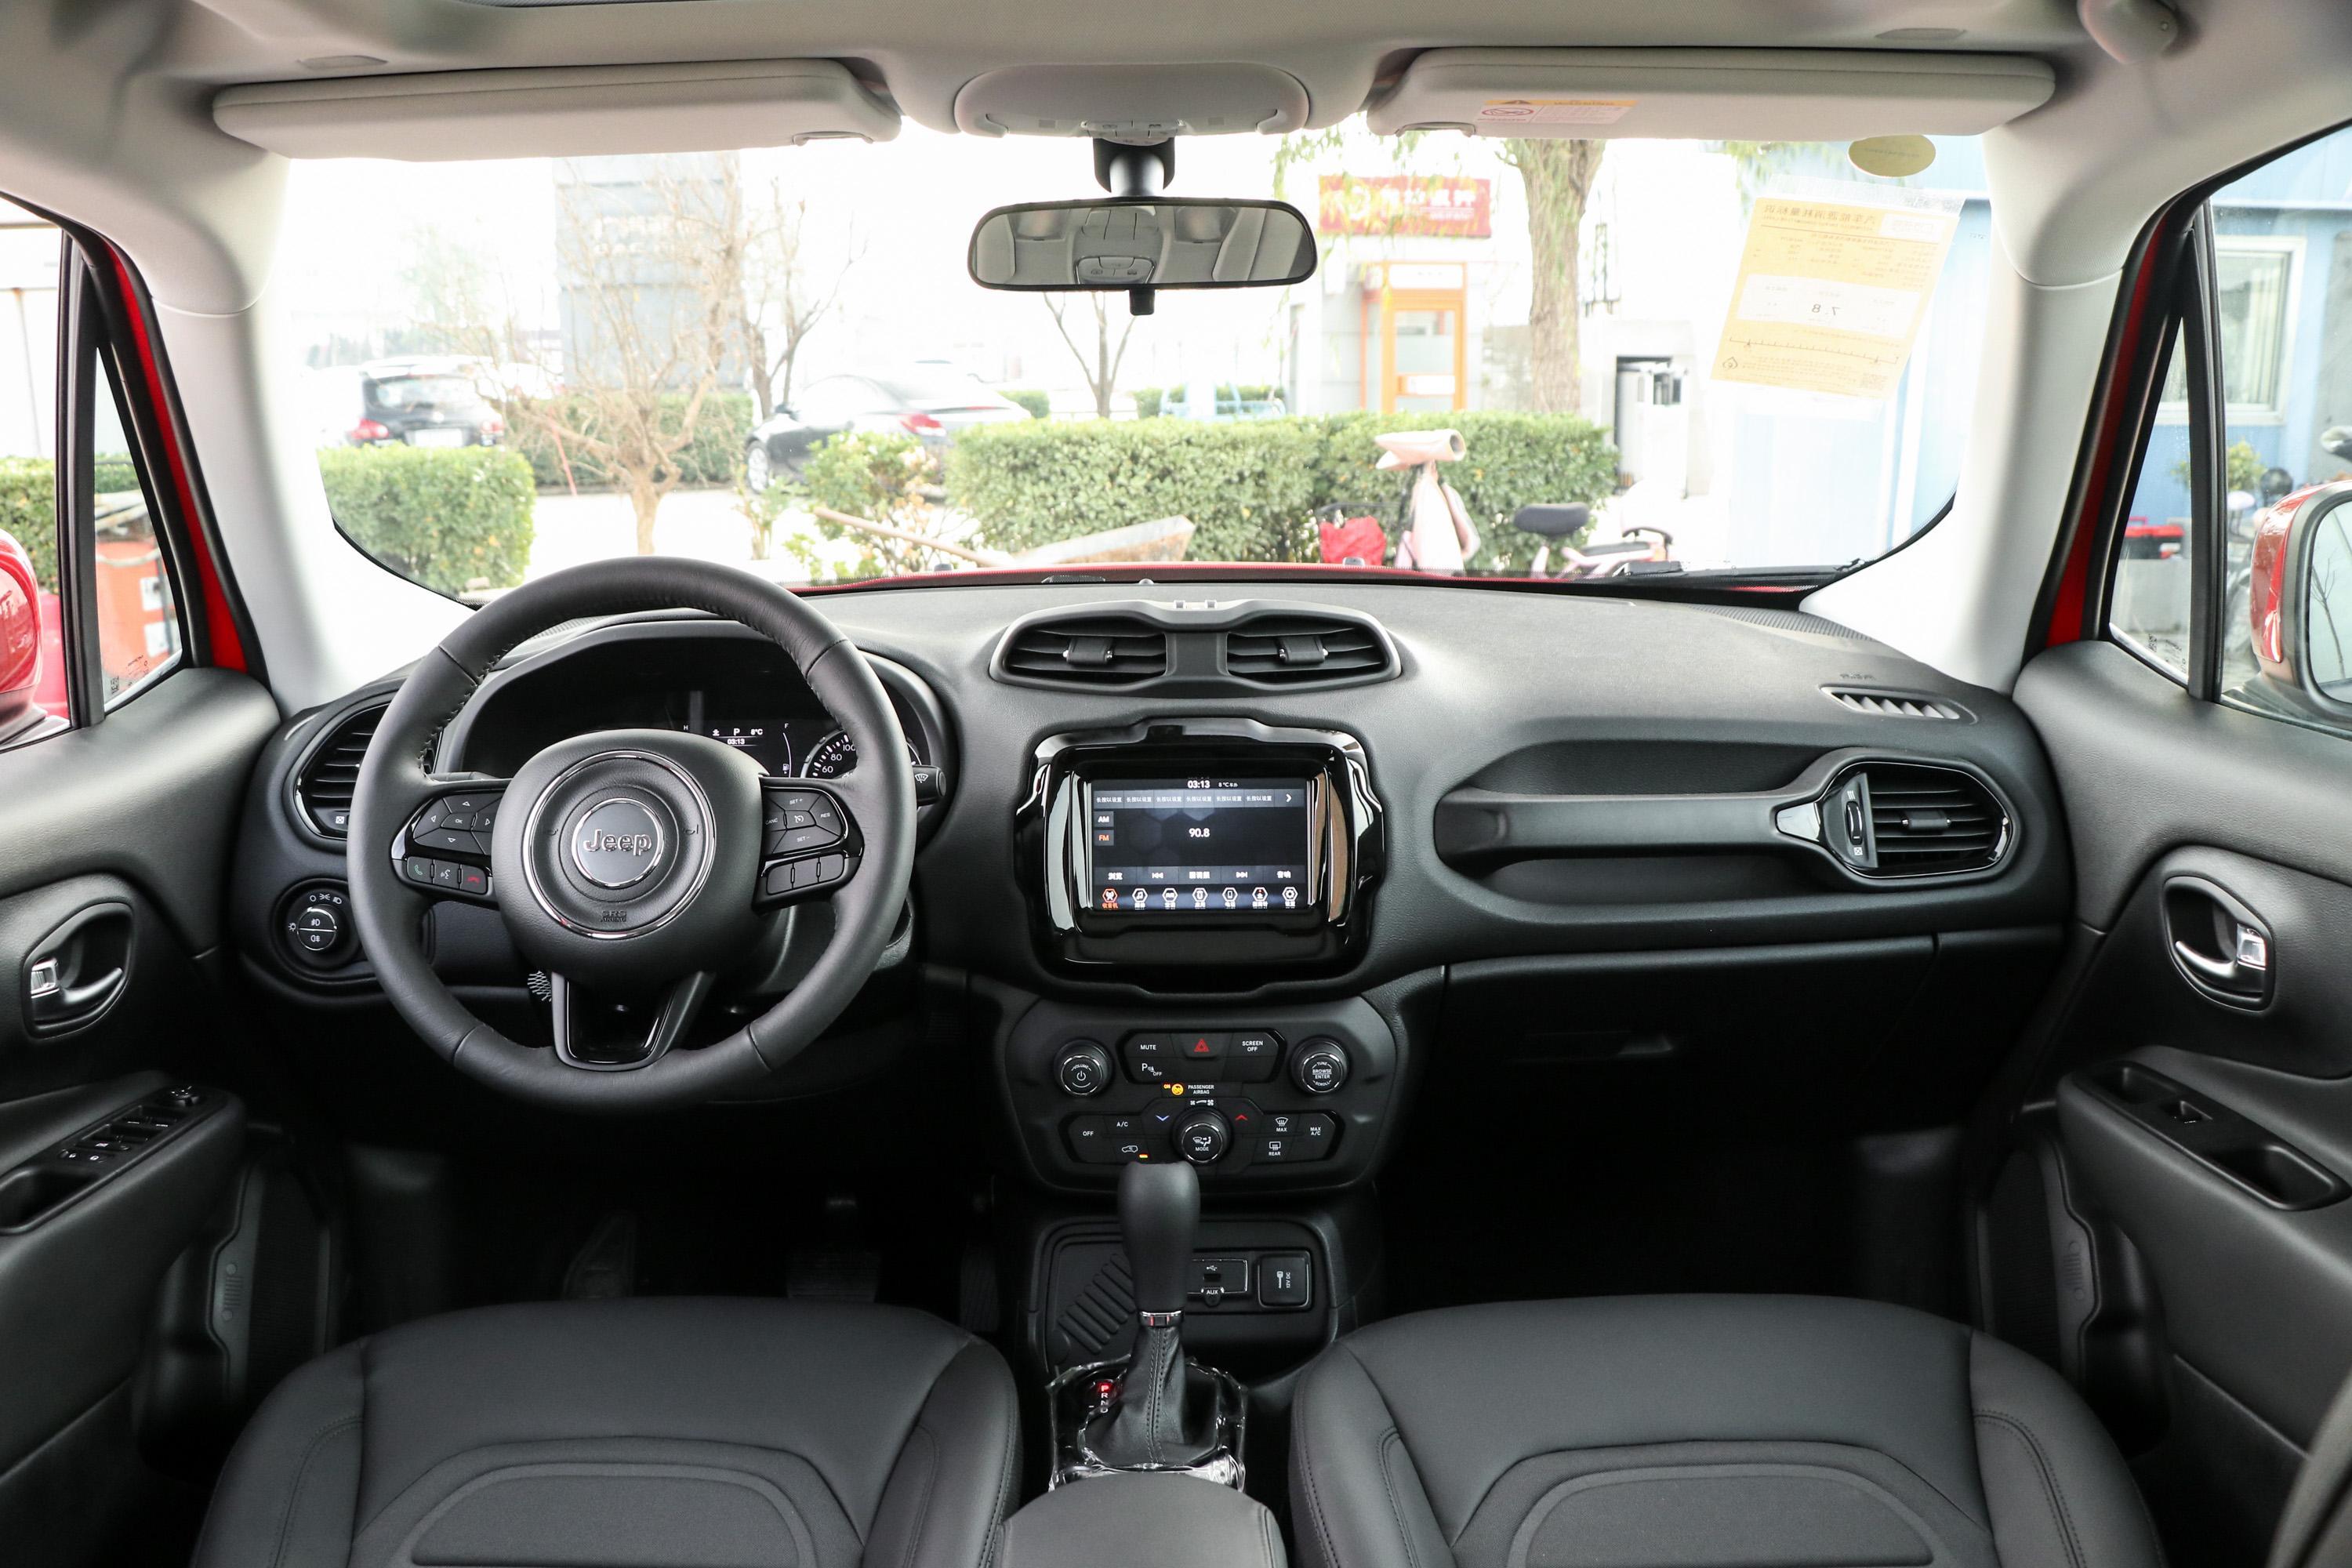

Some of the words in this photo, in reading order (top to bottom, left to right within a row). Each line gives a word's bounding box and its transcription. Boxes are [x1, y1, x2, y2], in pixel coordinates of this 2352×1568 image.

[733, 728, 740, 736] P
[1187, 779, 1210, 789] 03:13
[1189, 828, 1210, 837] 90.8
[583, 829, 652, 856] Jeep
